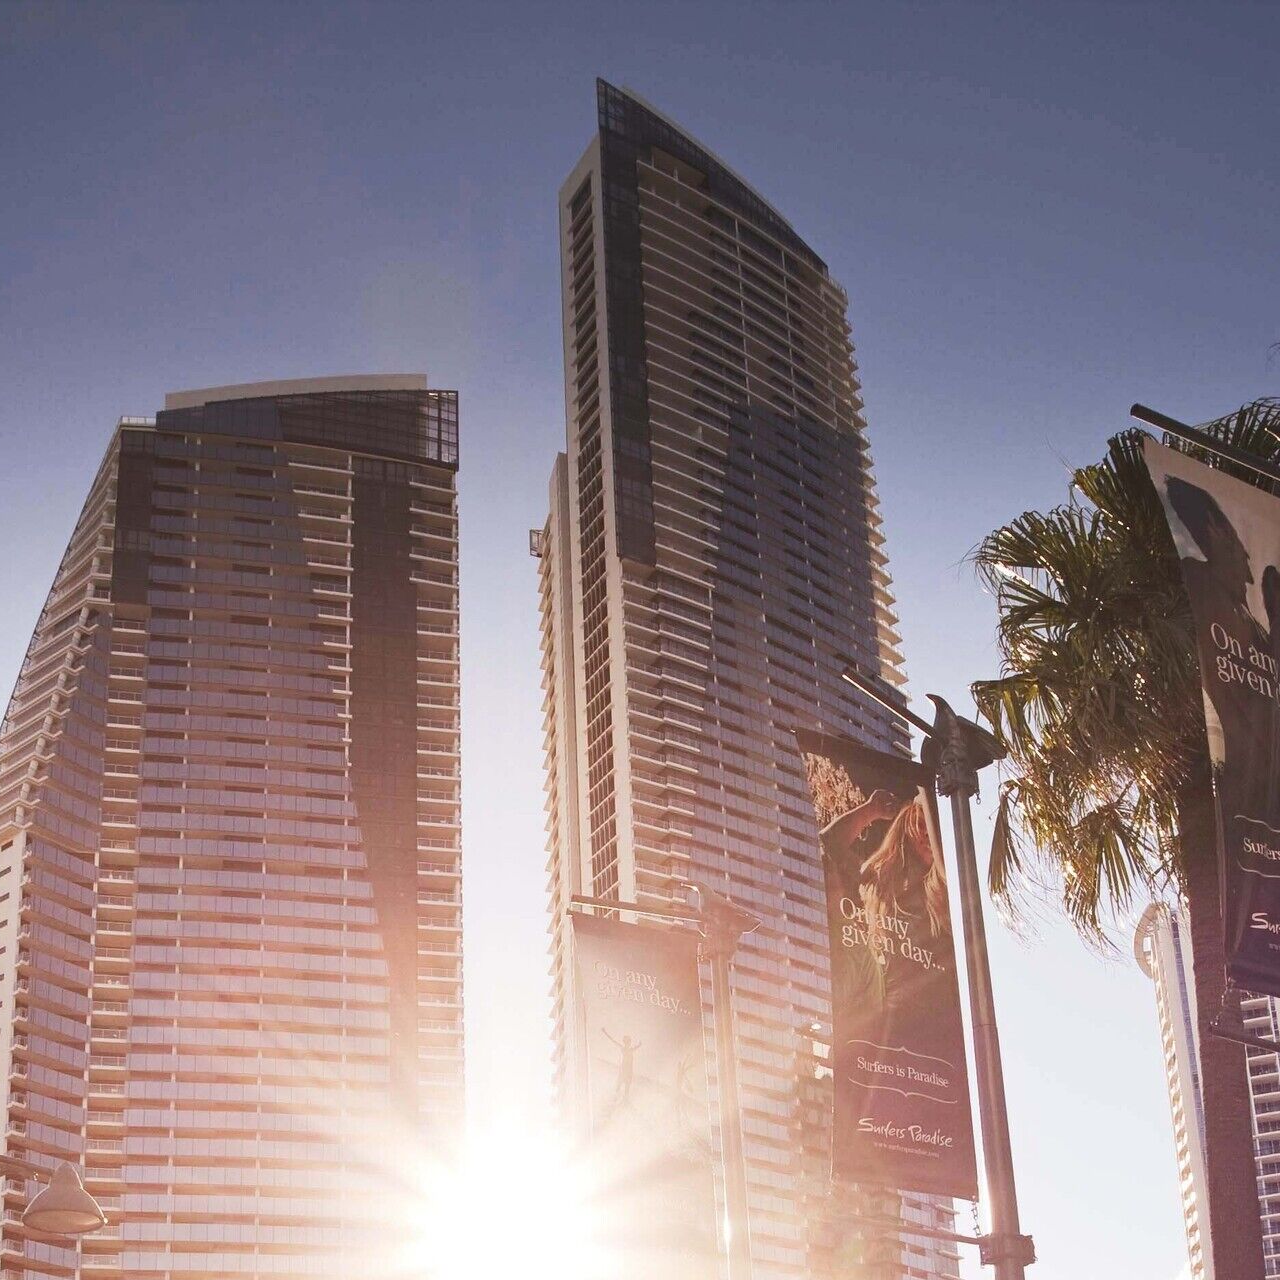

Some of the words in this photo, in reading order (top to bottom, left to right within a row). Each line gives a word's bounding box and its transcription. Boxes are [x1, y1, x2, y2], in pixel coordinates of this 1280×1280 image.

[1210, 622, 1245, 659] On
[1248, 644, 1280, 682] any
[1216, 654, 1274, 699] given
[840, 897, 870, 925] On
[876, 913, 910, 940] any
[841, 922, 896, 955] given
[900, 938, 945, 971] day...
[626, 970, 657, 991] any
[650, 989, 692, 1016] day...
[857, 1056, 894, 1075] Surfers
[895, 1064, 906, 1078] is
[907, 1067, 950, 1088] Paradise
[857, 1117, 906, 1139] Surfers
[908, 1125, 953, 1148] Paradise
